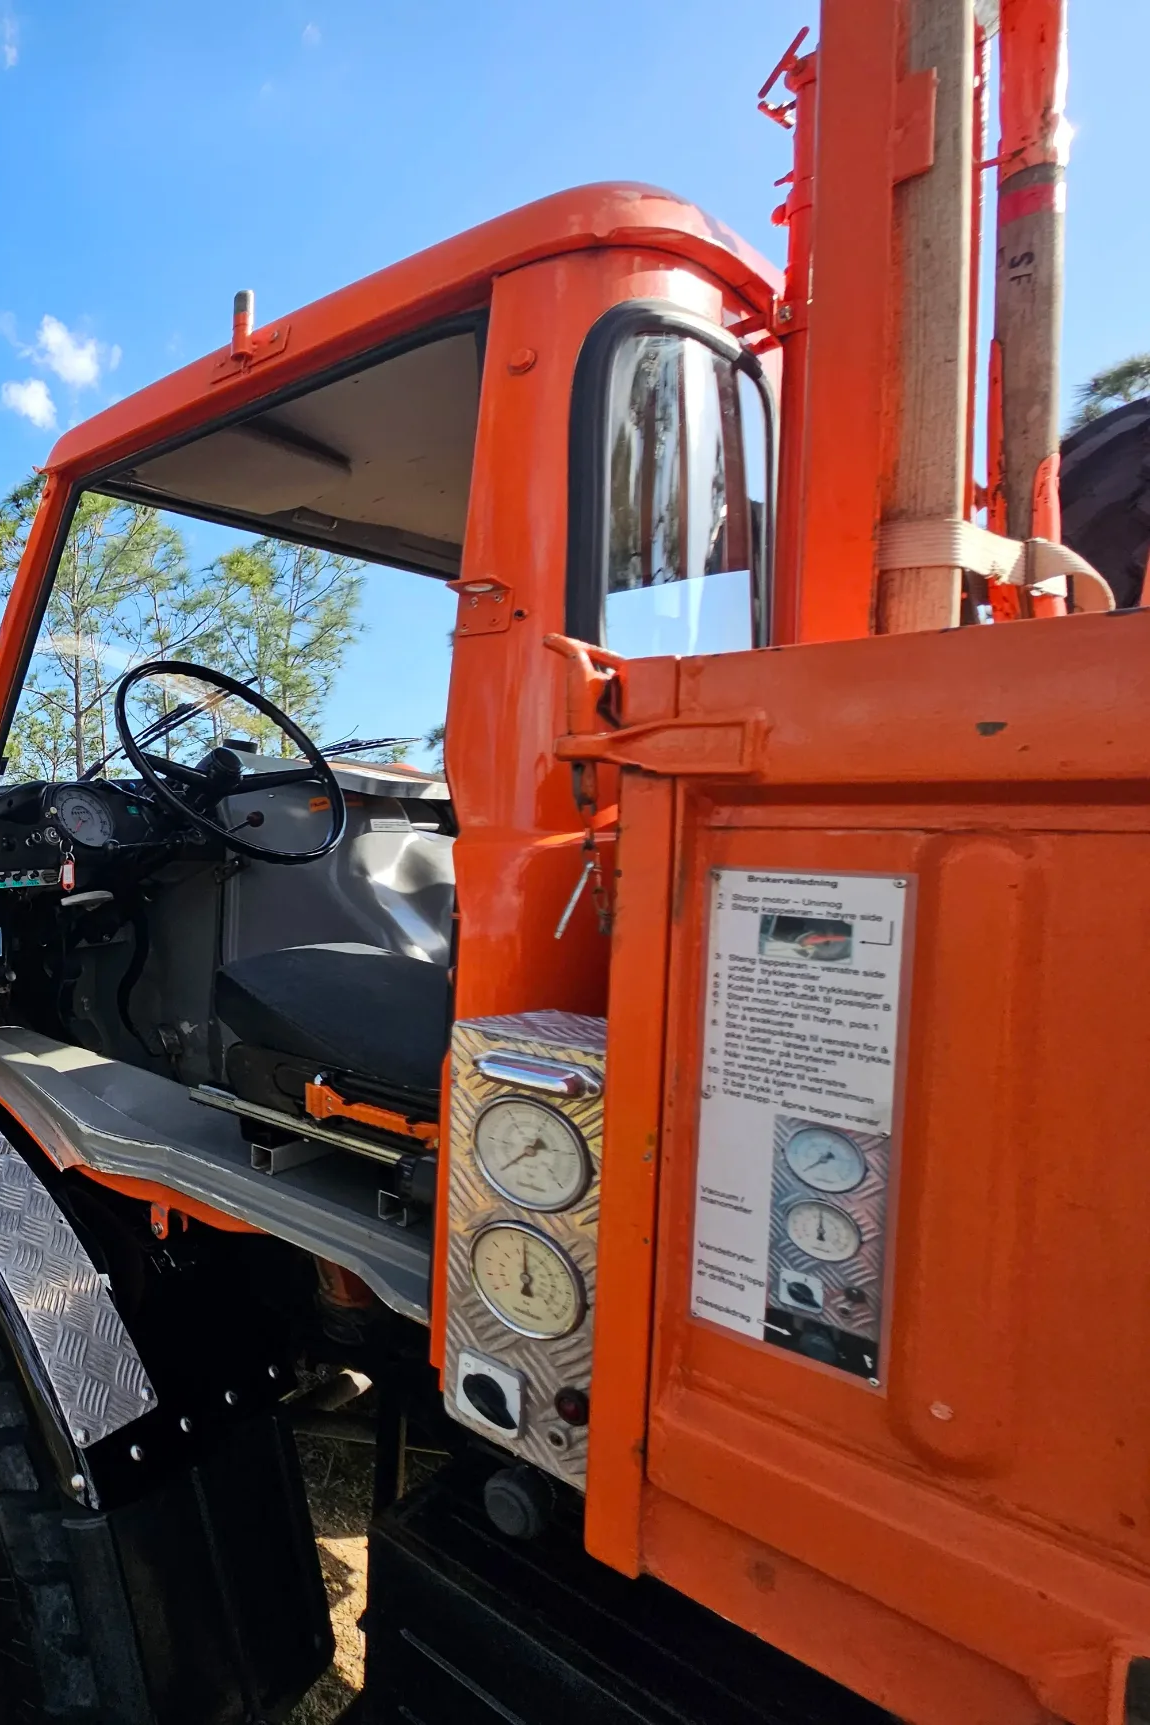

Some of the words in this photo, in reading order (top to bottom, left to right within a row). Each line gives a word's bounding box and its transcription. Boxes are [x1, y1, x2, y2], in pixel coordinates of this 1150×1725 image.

[747, 874, 838, 889] Brukerveiledning
[731, 903, 759, 913] Steng
[826, 910, 857, 920] høyre
[860, 914, 883, 922] side
[732, 893, 760, 903] Stopp
[802, 898, 843, 910] Unimog
[728, 965, 755, 973] under
[729, 954, 756, 965] Steng
[759, 958, 808, 969] tappekran
[820, 966, 860, 976] venstre
[862, 970, 886, 979] side
[727, 983, 754, 993] Koble
[774, 989, 820, 1001] kraftuttak
[835, 999, 880, 1010] posisjon
[728, 974, 755, 983] Koble
[772, 980, 800, 989] suge-
[802, 984, 816, 992] og
[818, 985, 884, 1000] trykkslanger
[727, 992, 749, 1002] Start
[751, 997, 779, 1006] motor
[791, 1000, 832, 1015] Unimog
[742, 1006, 799, 1018] vendebryter
[749, 1016, 794, 1028] evakuere
[725, 1021, 747, 1030] Skru
[749, 1026, 806, 1042] gasspådrag
[809, 1034, 818, 1042] til
[820, 1038, 860, 1049] venstre
[863, 1042, 878, 1051] for
[744, 1034, 771, 1044] turtall
[812, 1046, 823, 1054] ut
[825, 1048, 845, 1057] ved
[857, 1053, 891, 1066] trykke
[746, 1045, 776, 1055] senter
[778, 1050, 791, 1058] på
[793, 1052, 837, 1066] bryteren
[724, 1050, 741, 1058] Når
[744, 1055, 767, 1063] vann
[783, 1061, 819, 1073] pumpe
[723, 1068, 746, 1080] Sørg
[772, 1078, 798, 1089] kjøre
[799, 1084, 823, 1094] med
[825, 1089, 875, 1104] minimum
[731, 1080, 746, 1088] bar
[748, 1083, 772, 1093] trykk
[737, 1063, 795, 1077] vendebryter
[796, 1073, 805, 1081] til
[808, 1076, 847, 1088] venstre
[722, 1087, 741, 1097] Ved
[743, 1093, 770, 1104] stopp
[781, 1099, 807, 1112] åpne
[808, 1105, 843, 1119] begge
[844, 1113, 881, 1126] kraner
[700, 1185, 739, 1202] Vacuum
[700, 1195, 753, 1215] manometer
[697, 1258, 736, 1277] Posisjon
[695, 1295, 751, 1323] Gasspådrag
